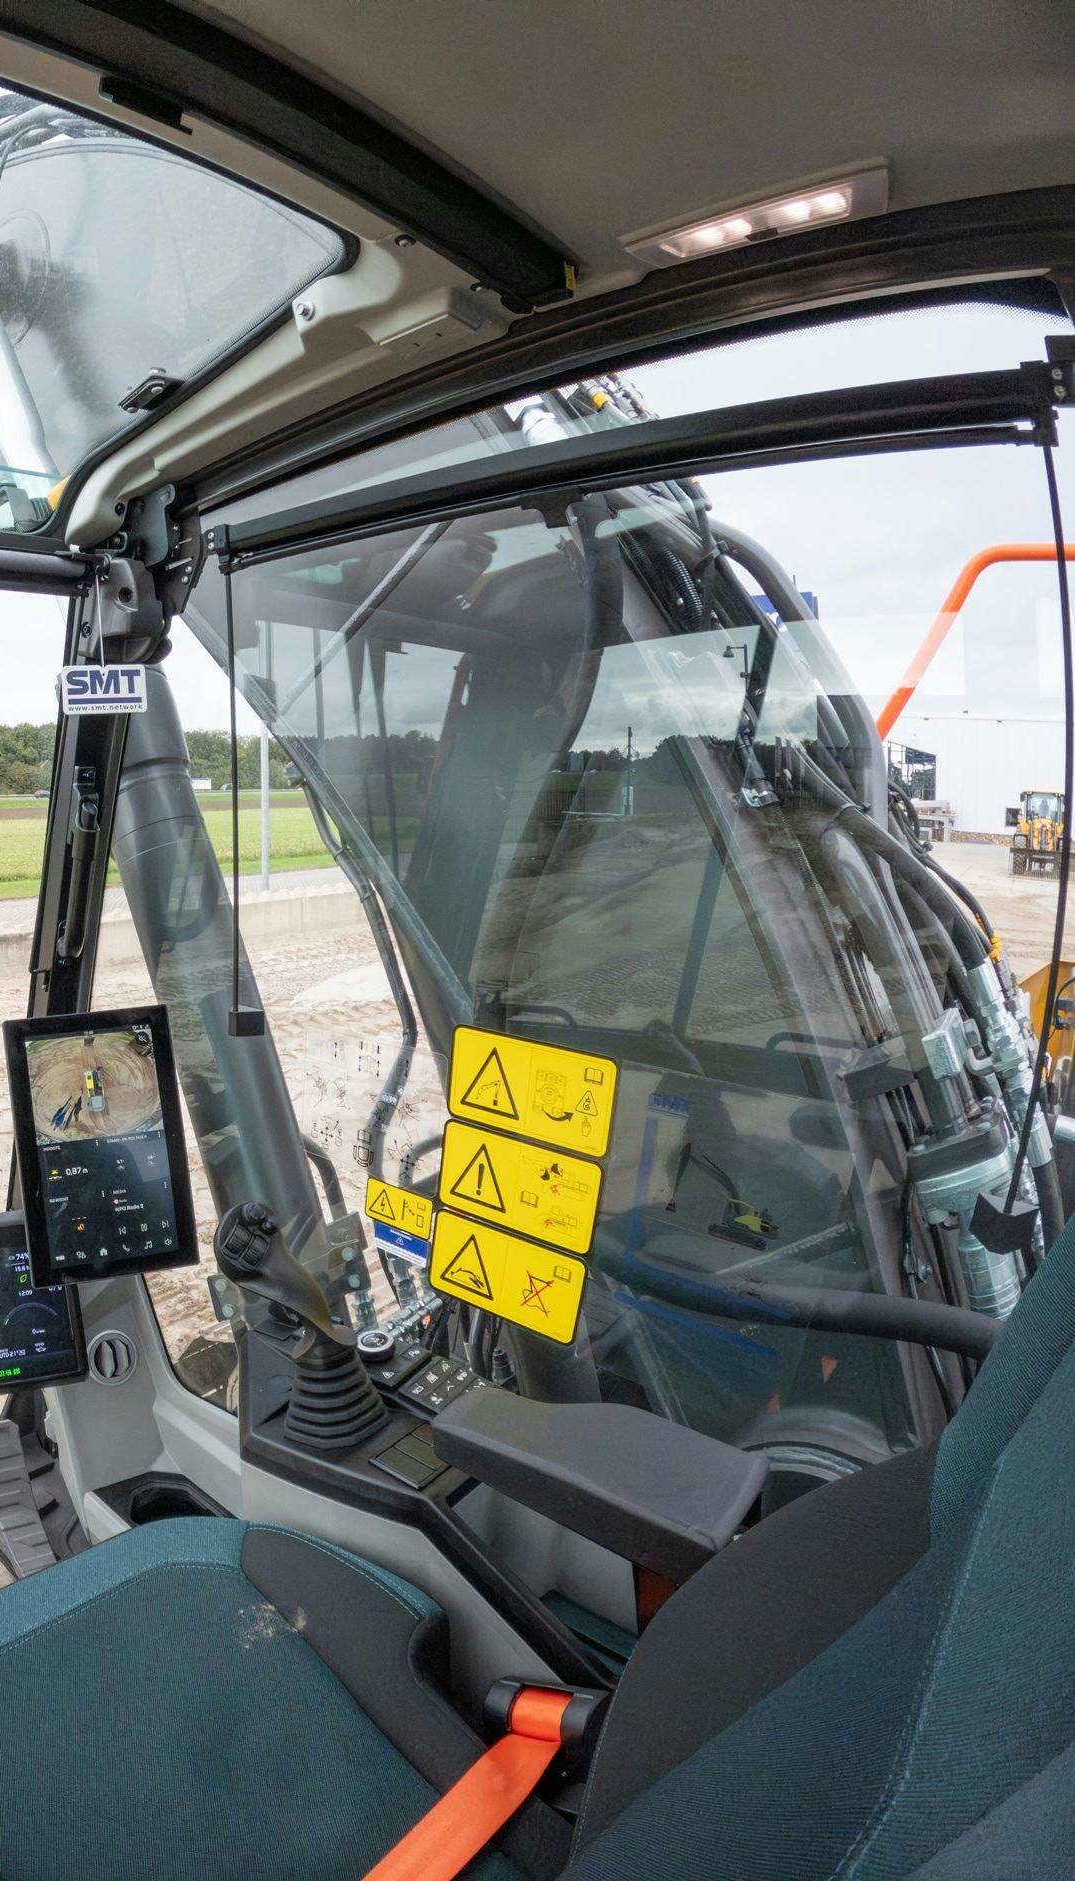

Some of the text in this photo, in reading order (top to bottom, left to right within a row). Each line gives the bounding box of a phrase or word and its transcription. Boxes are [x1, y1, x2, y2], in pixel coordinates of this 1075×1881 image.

[66, 670, 141, 695] SMT
[68, 704, 143, 712] www.smt.network
[65, 1166, 82, 1176] 0,87
[19, 1289, 33, 1297] 12:09
